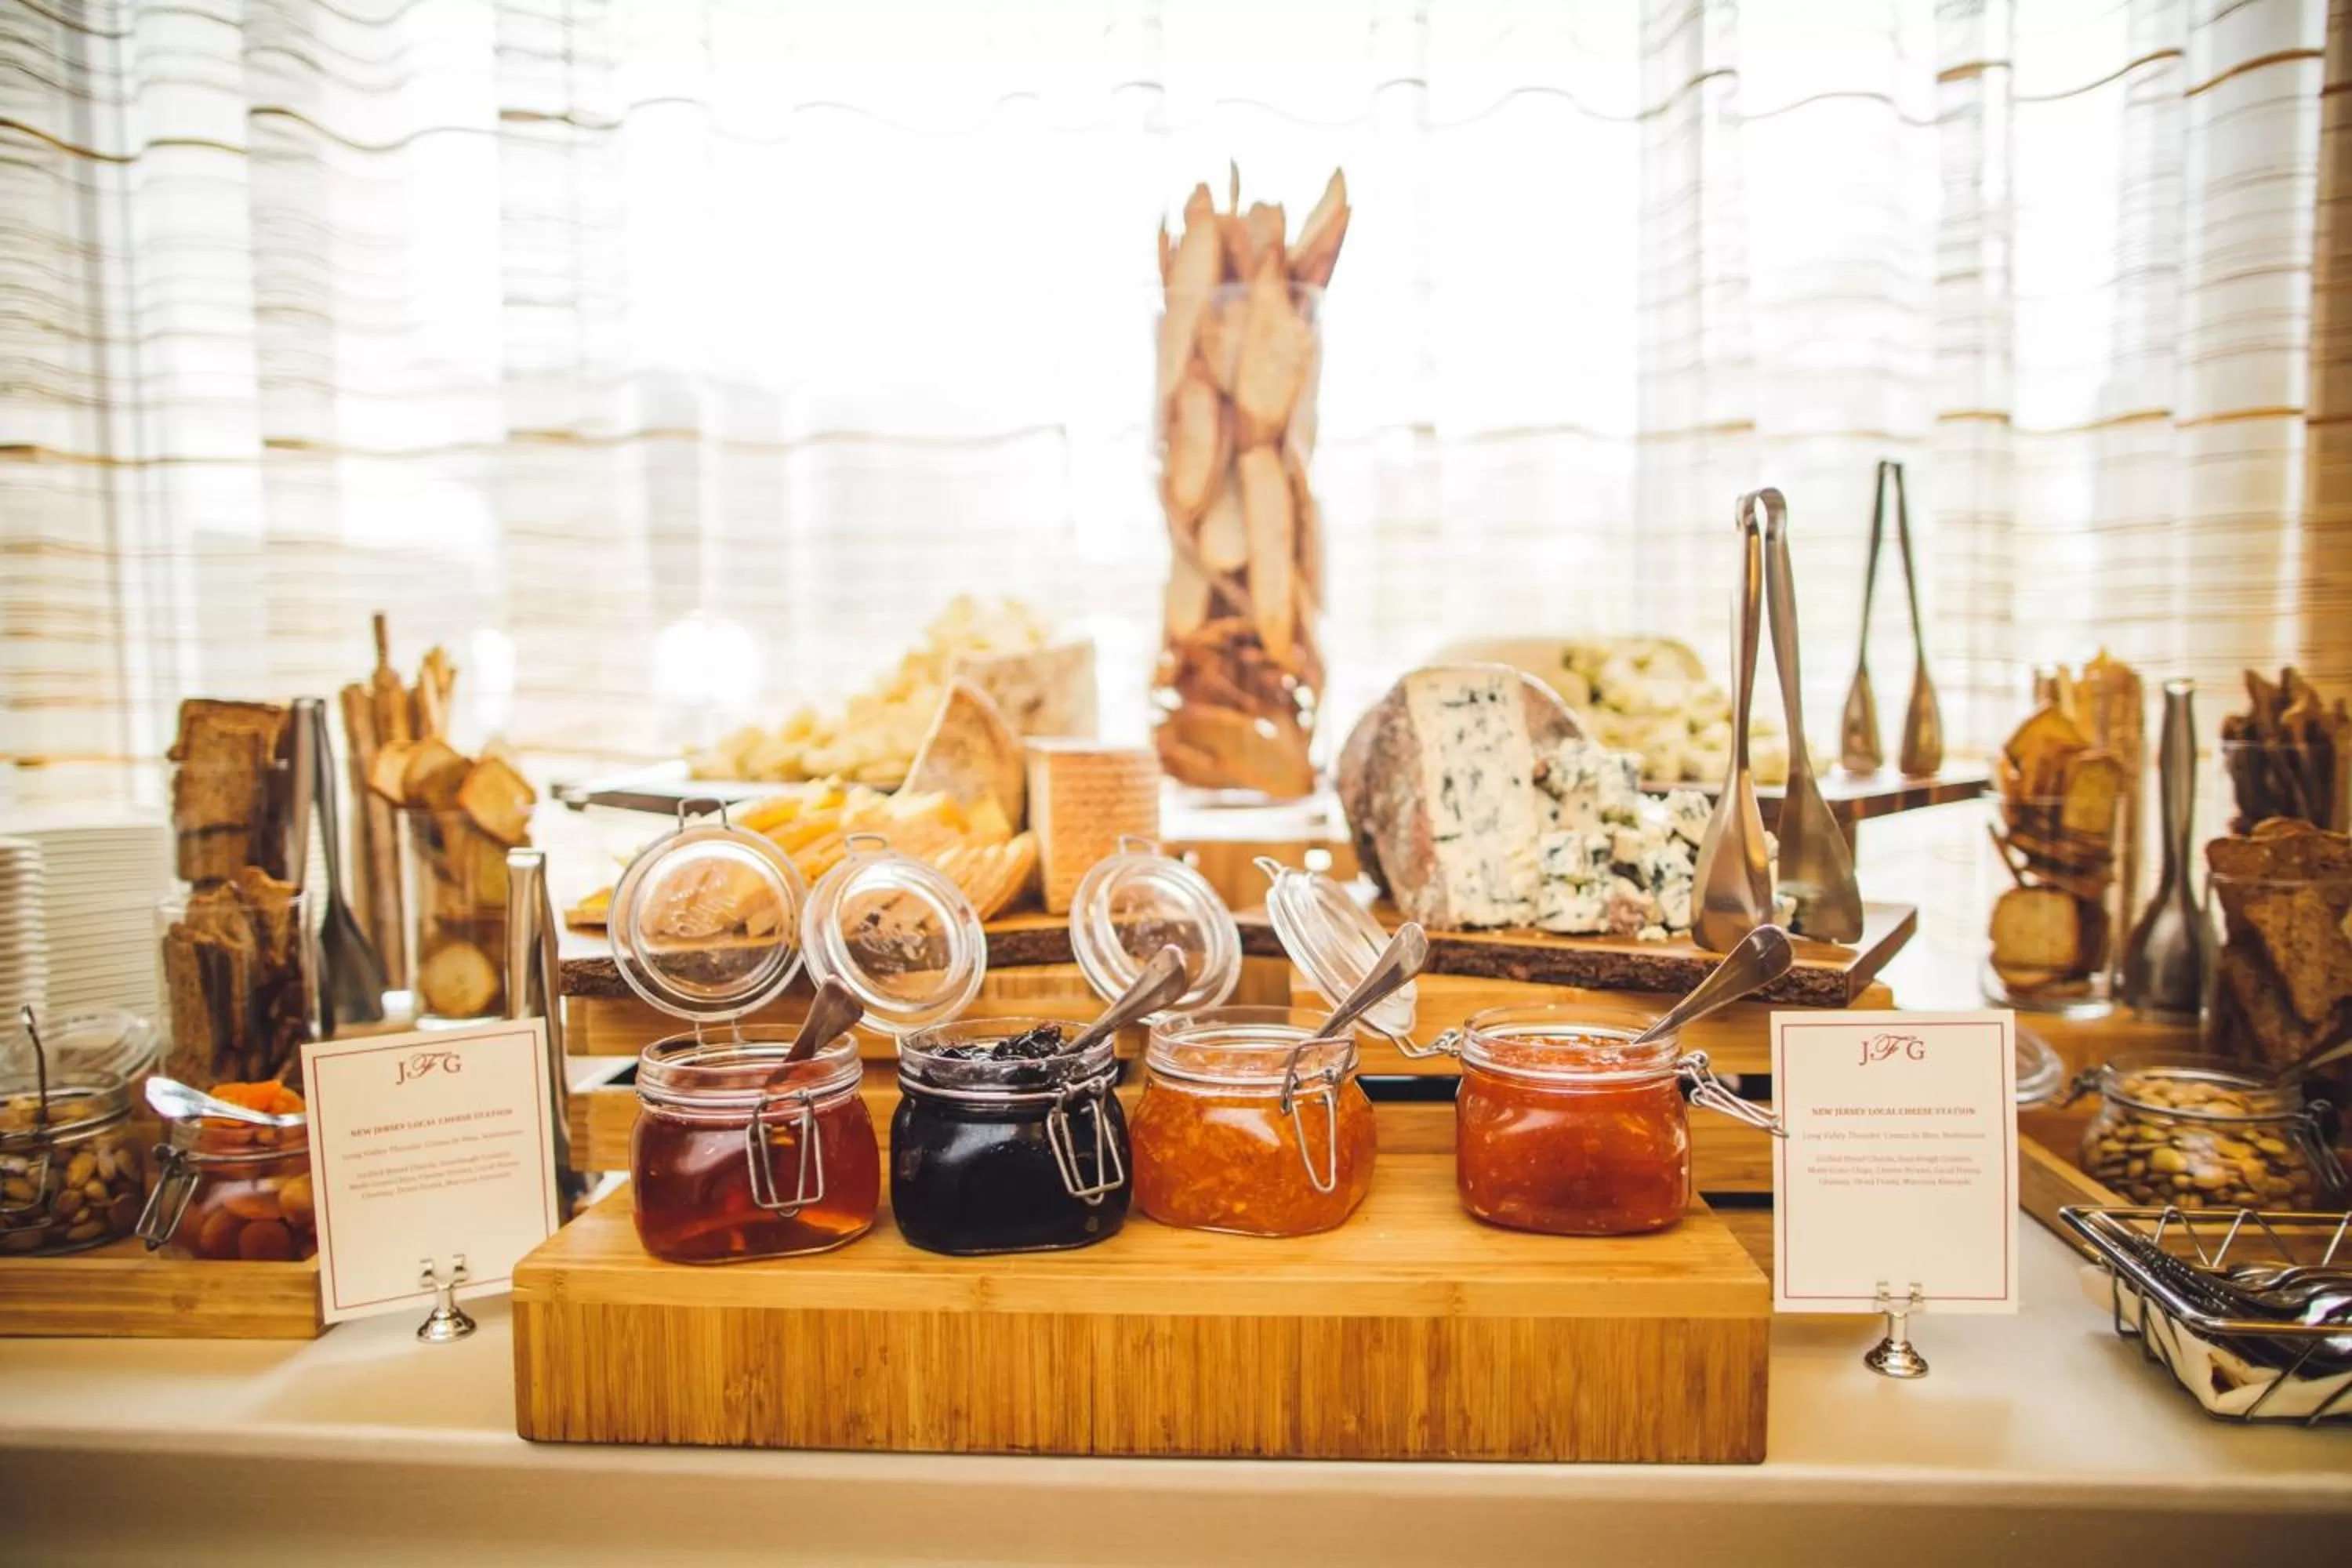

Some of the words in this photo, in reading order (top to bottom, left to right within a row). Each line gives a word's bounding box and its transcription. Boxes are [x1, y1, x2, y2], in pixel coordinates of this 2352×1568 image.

[1812, 1107, 1831, 1116] NEW
[1835, 1107, 1865, 1116] JERSEY
[1868, 1107, 1895, 1116] LOCAL
[1897, 1107, 1932, 1116] CHEESE
[1934, 1107, 1976, 1116] STATION
[350, 1128, 372, 1137] NEW
[374, 1123, 405, 1135] JERSEY
[407, 1118, 436, 1129] LOCAL
[438, 1112, 472, 1124] CHEESE
[474, 1108, 513, 1119] STATION
